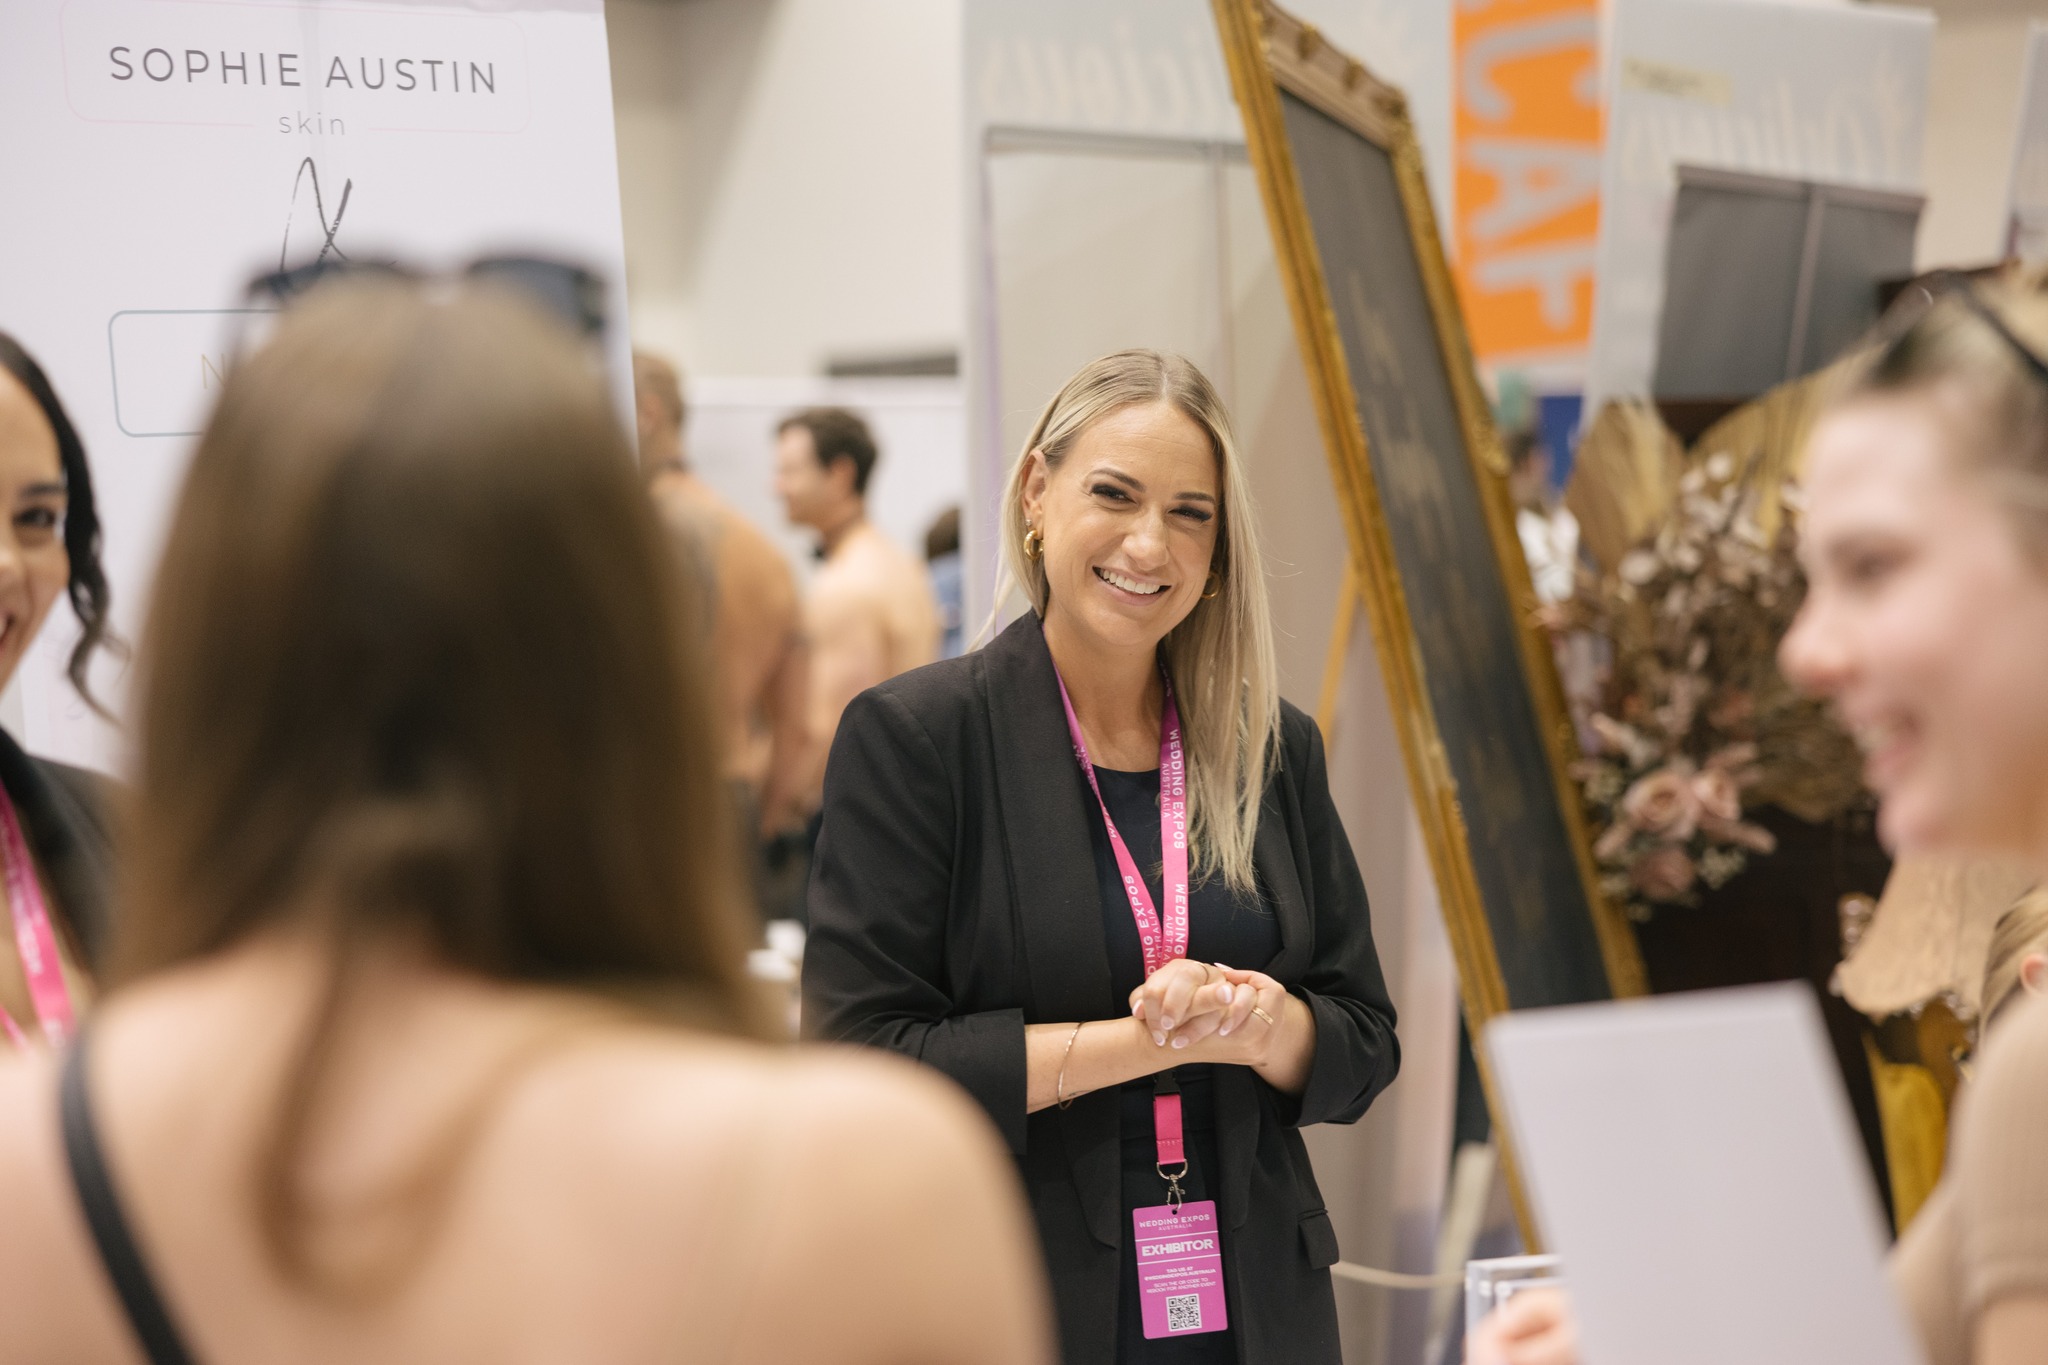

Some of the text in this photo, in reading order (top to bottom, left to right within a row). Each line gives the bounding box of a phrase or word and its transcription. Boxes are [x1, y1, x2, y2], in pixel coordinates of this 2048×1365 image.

[110, 46, 495, 94] SOPHIE AUSTIN
[279, 110, 345, 136] skin
[1162, 763, 1171, 818] AUSTRALIA
[1169, 729, 1184, 849] WEDDING EXPOS
[1125, 875, 1150, 928] EXPOS
[1174, 883, 1186, 955] WEDDING
[1139, 1214, 1210, 1227] WEDDING EXPOS
[1142, 1239, 1213, 1256] EXHIBITOR
